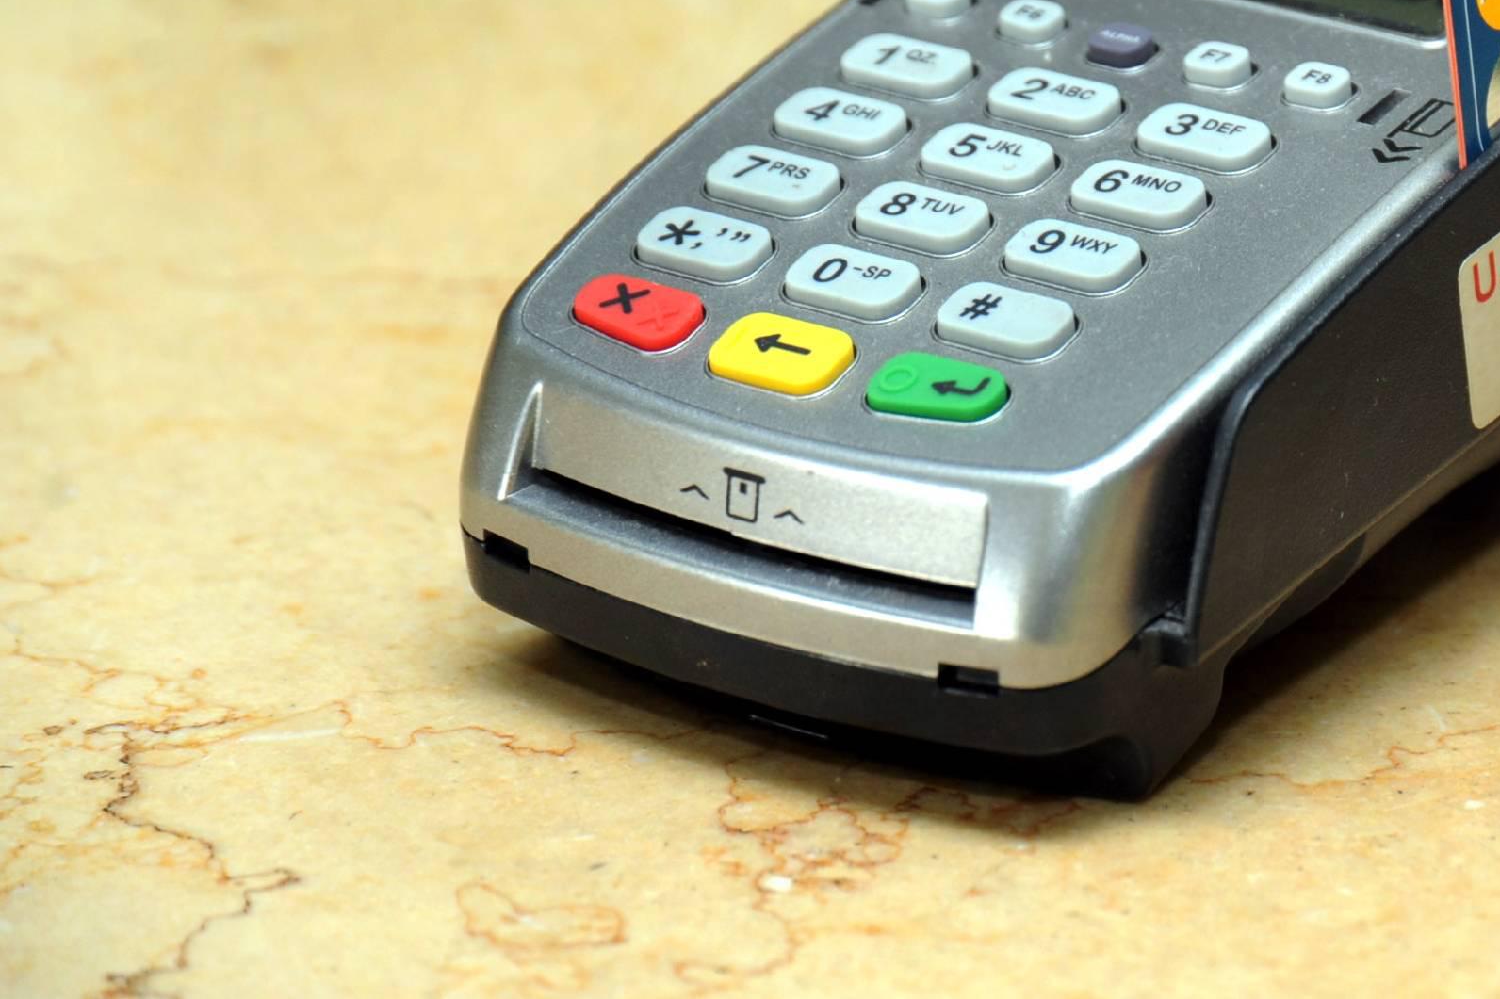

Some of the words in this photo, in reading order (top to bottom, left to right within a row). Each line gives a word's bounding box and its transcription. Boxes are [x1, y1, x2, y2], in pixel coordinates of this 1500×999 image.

[1200, 49, 1232, 63] F7
[1301, 69, 1332, 84] F8
[1011, 78, 1047, 100] 2
[1050, 82, 1096, 100] ABC
[804, 99, 841, 122] 4
[843, 104, 881, 121] GHI
[1165, 112, 1199, 136] 3
[1201, 119, 1247, 137] DEF
[948, 134, 987, 158] 5
[986, 140, 1023, 158] JKL
[732, 155, 770, 179] 7
[768, 160, 810, 181] PRS
[1093, 169, 1129, 194] 6
[1131, 175, 1183, 194] MNO
[879, 191, 916, 216] 8
[922, 197, 966, 216] TUV
[1029, 228, 1066, 254] 9
[1070, 236, 1118, 255] WXY
